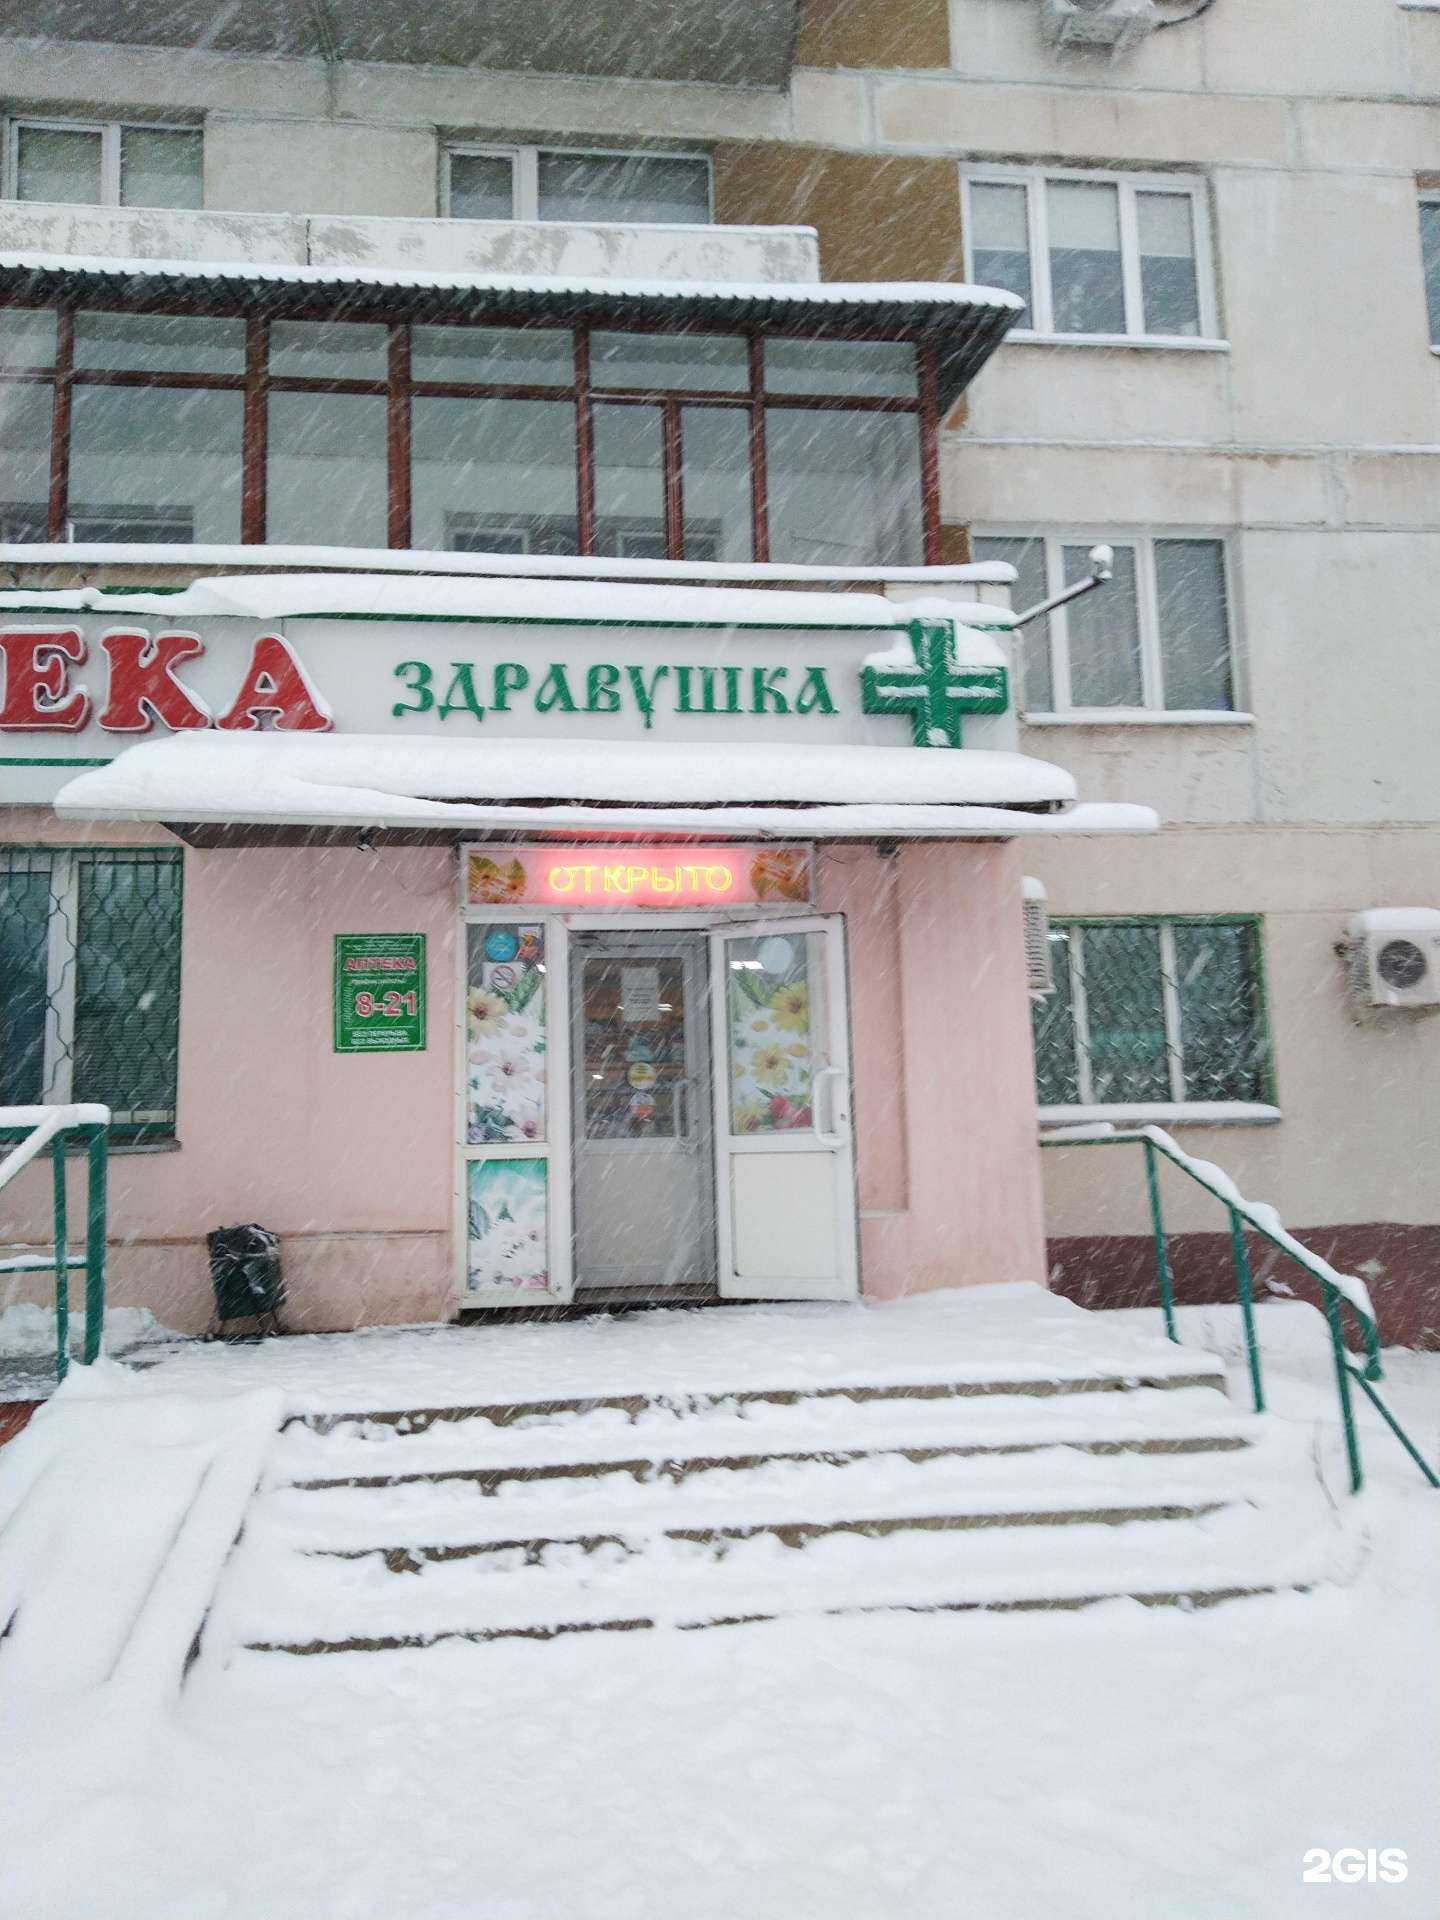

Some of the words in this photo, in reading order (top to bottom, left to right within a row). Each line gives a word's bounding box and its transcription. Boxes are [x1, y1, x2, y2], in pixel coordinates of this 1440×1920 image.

[0, 625, 335, 732] ЕКА
[392, 660, 841, 729] ЗДРАВУШКА
[548, 864, 733, 894] ОТКРЫТО
[355, 991, 417, 1017] 8-21
